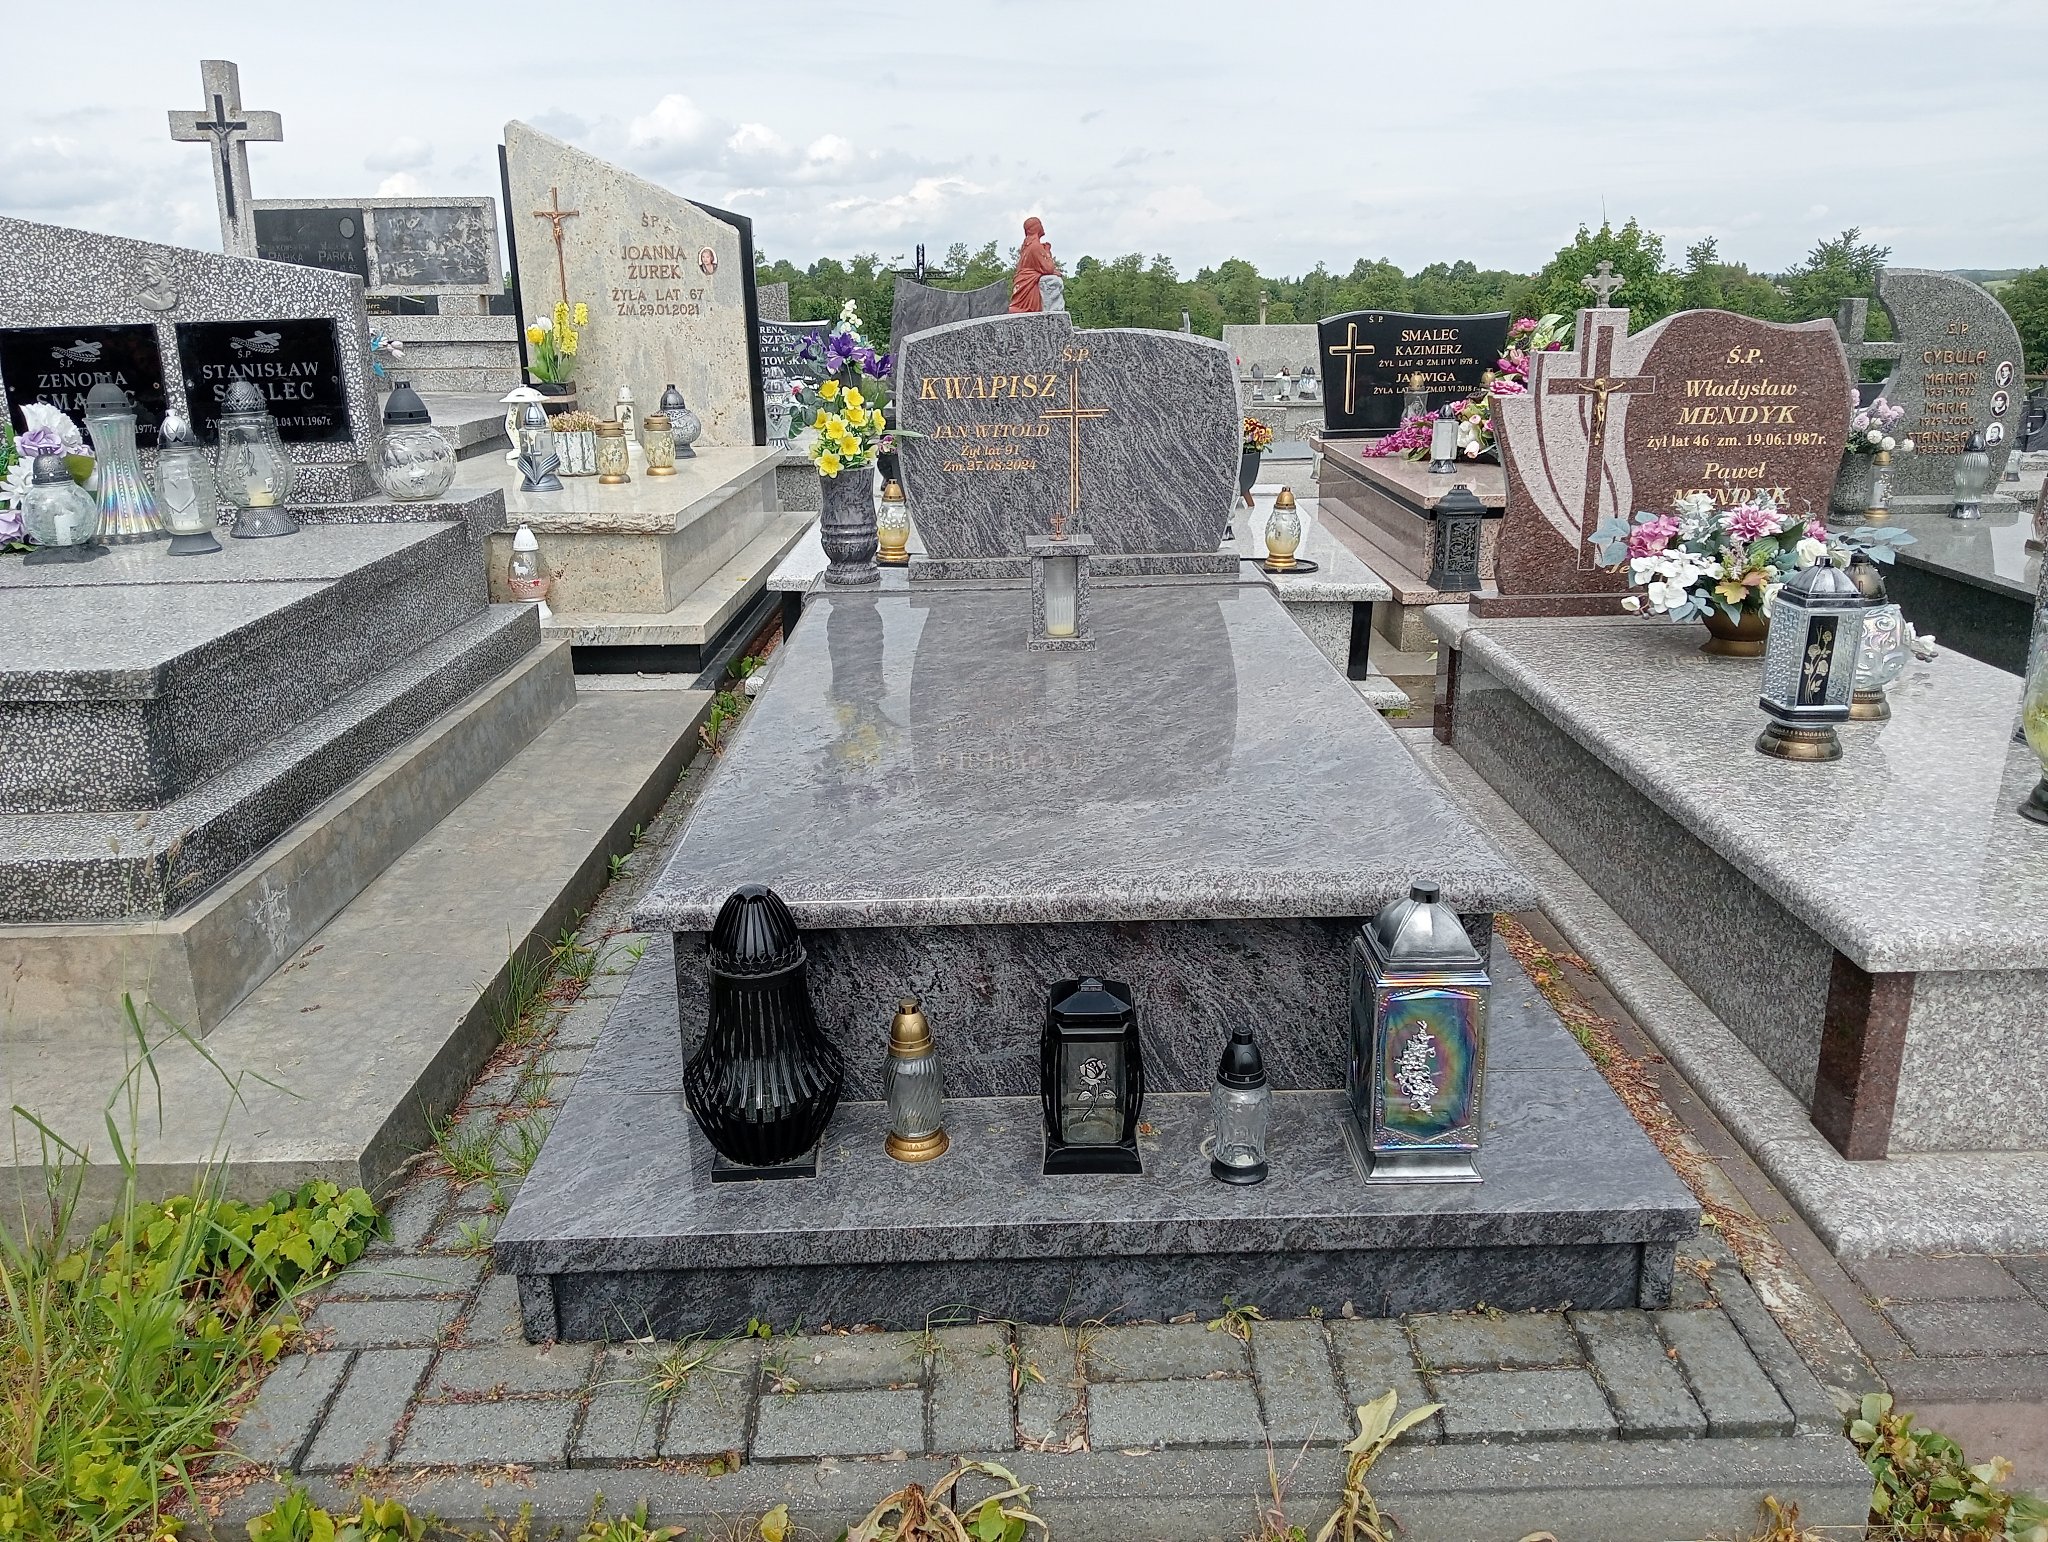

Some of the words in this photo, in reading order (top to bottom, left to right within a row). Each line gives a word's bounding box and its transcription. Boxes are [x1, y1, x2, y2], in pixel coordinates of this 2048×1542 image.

[318, 250, 354, 262] PARKA
[621, 245, 687, 261] JOANNA
[628, 262, 681, 280] ŻUREK
[655, 288, 680, 301] LAT
[689, 287, 704, 301] 67
[759, 326, 783, 334] RENA
[1401, 328, 1459, 342] SMALEC
[1395, 344, 1462, 356] KAZIMIERZ
[1726, 345, 1764, 364] Ś.P.
[202, 361, 319, 379] STANISŁAW
[1399, 359, 1412, 367] LAT
[1396, 372, 1456, 383] JAWIGA
[1924, 371, 1978, 386] MARIAN
[919, 373, 1057, 400] KWAPISZ
[1685, 377, 1797, 400] Władysław
[1676, 405, 1800, 426] MENDYK
[1925, 402, 1969, 414] MARIA
[931, 425, 972, 440] JAN
[974, 423, 1050, 439] WITOLD
[1647, 435, 1668, 450] żył
[1671, 435, 1689, 447] lat
[1693, 434, 1710, 447] 46
[1716, 436, 1742, 447] zm.
[1746, 433, 1827, 447] 19.06.1987r.
[1702, 461, 1767, 480] Paweł
